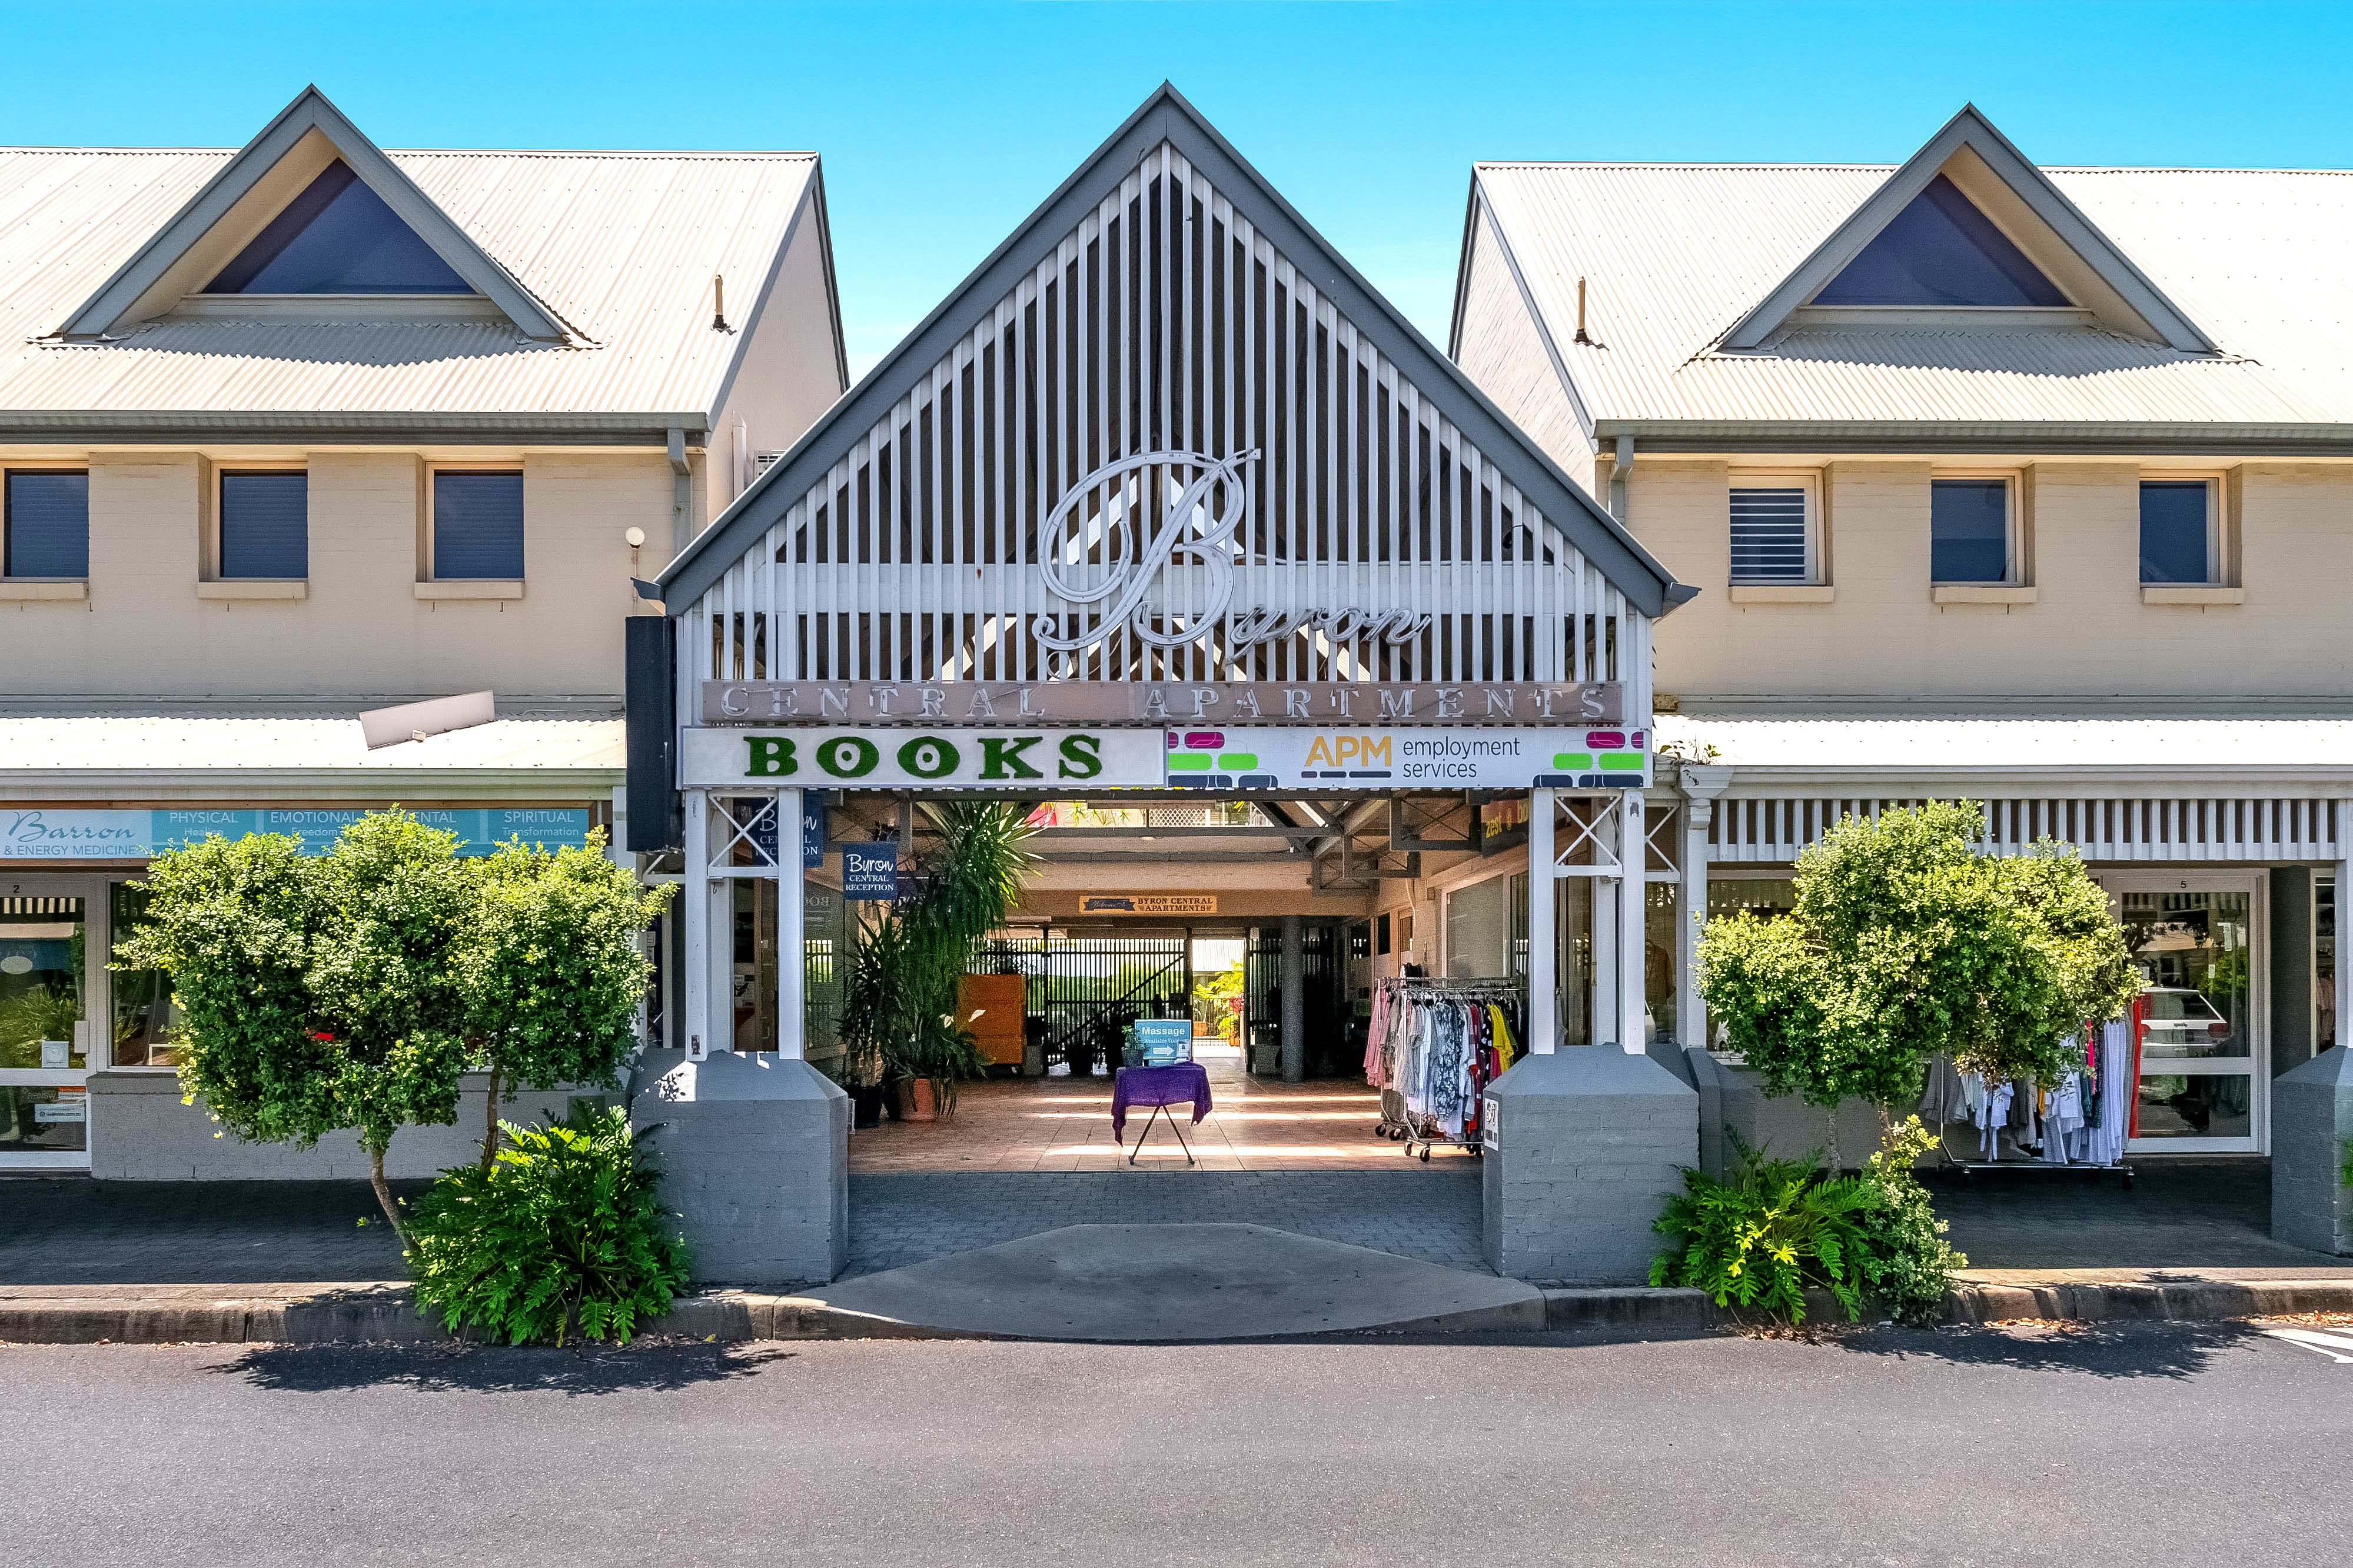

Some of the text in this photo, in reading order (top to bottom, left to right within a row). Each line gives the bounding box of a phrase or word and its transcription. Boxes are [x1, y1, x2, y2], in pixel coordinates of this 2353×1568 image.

[1032, 448, 1431, 665] Byron
[721, 687, 1606, 718] CENTRAL APARTMENTS
[743, 734, 1102, 779] BOOKS
[1304, 735, 1520, 767] APM employment
[1403, 759, 1477, 778] services
[8, 811, 136, 842] Barron
[170, 811, 239, 824] PHYSICAL
[270, 811, 357, 824] EMOTIONAL
[504, 811, 575, 823] SPIRITUAL
[1486, 811, 1502, 838] zest
[291, 827, 338, 836] Freedom
[5, 845, 137, 855] & ENERGY MEDICINE
[846, 854, 893, 878] Byron
[13, 884, 20, 893] 2
[2180, 880, 2187, 889] 5
[1142, 1027, 1185, 1037] Massage
